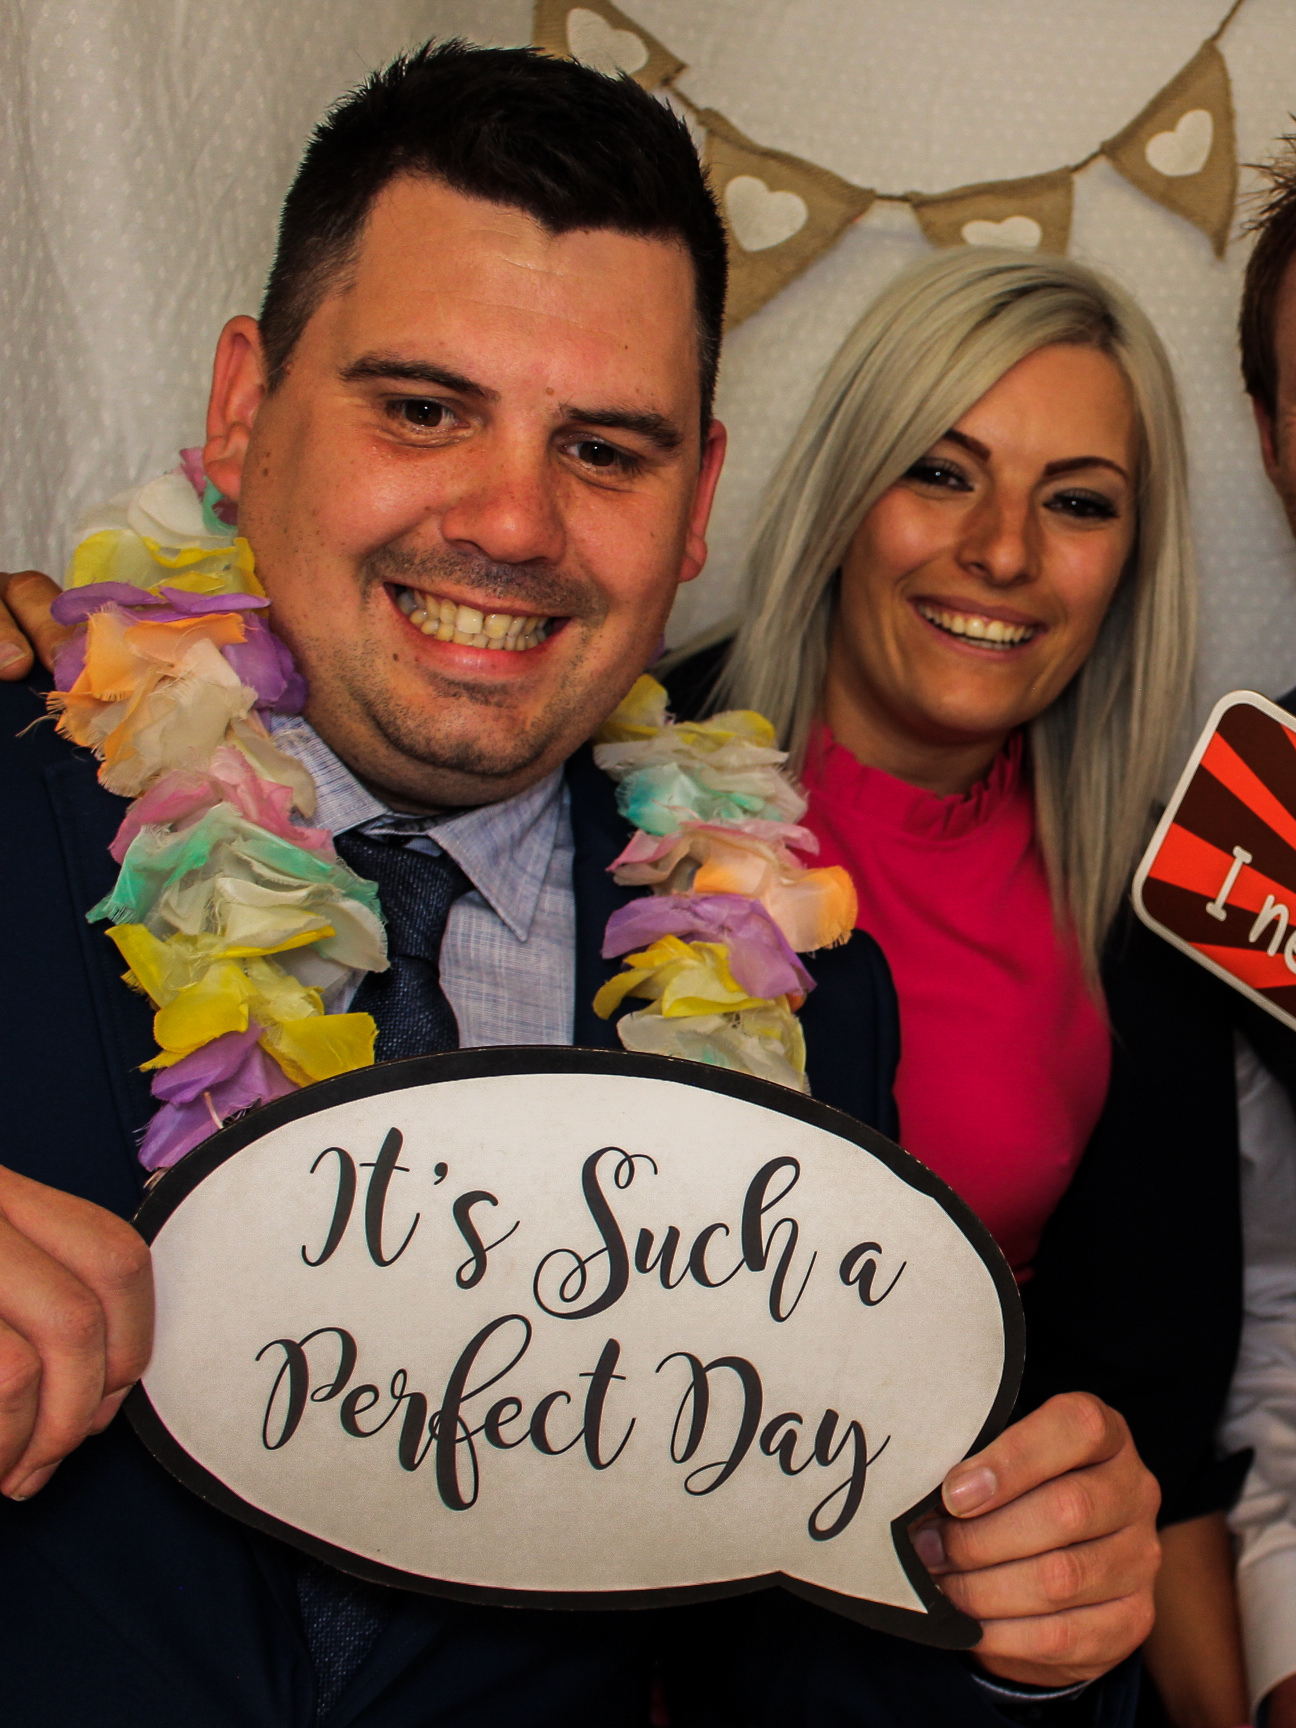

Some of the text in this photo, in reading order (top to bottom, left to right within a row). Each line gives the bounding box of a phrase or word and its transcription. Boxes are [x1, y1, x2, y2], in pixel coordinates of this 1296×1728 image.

[1205, 846, 1252, 921] I
[533, 1146, 818, 1322] Such
[838, 1241, 907, 1306] a
[254, 1313, 891, 1542] Perfect Day
